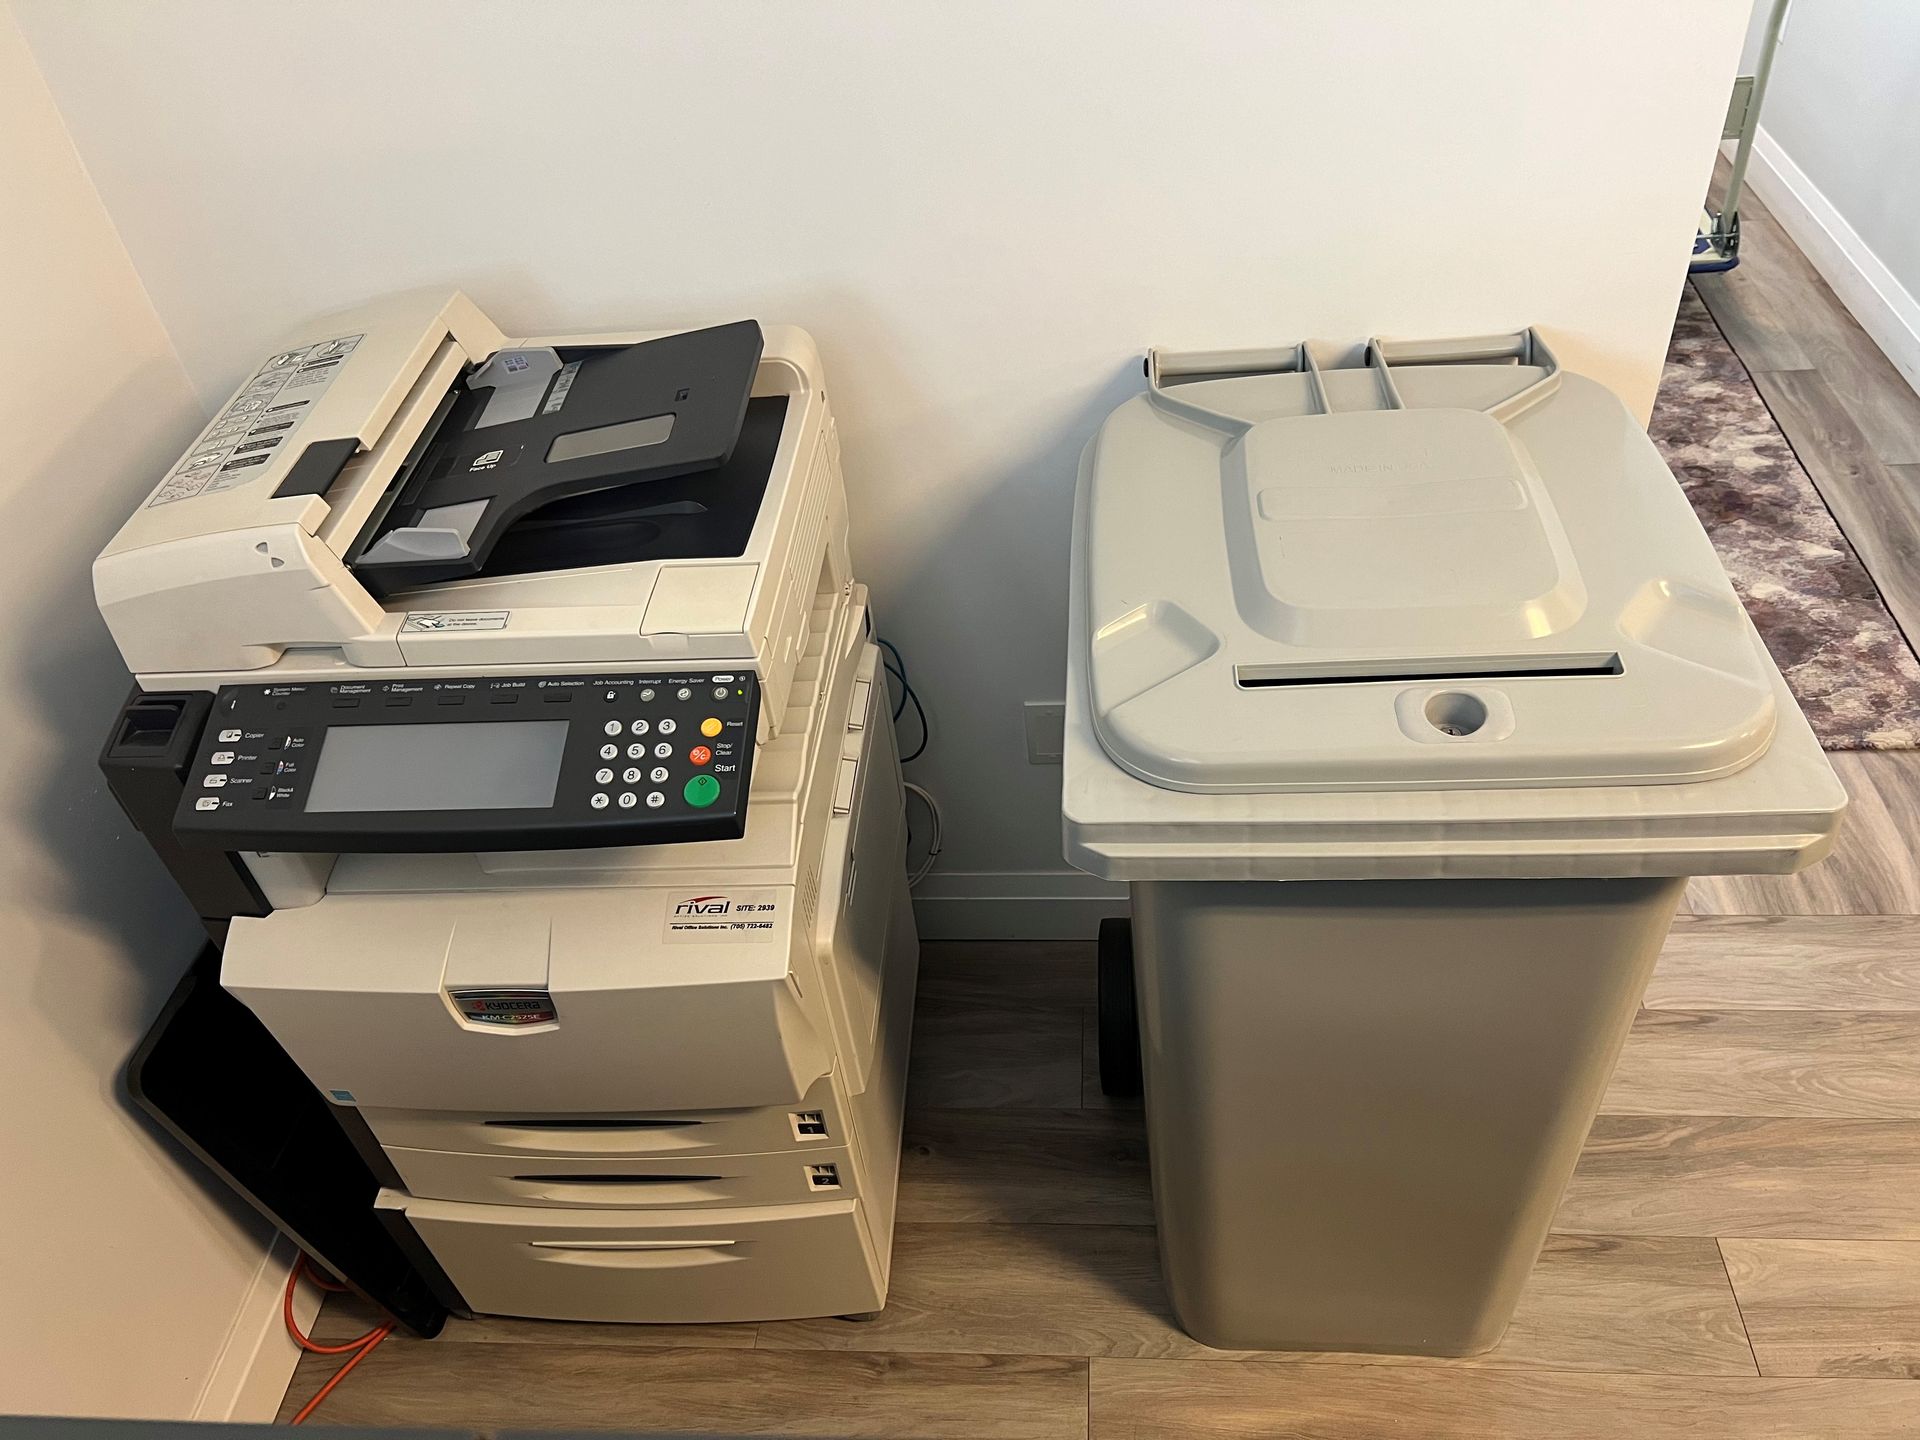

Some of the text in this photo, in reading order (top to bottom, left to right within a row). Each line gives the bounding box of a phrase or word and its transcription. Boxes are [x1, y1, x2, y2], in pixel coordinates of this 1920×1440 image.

[610, 721, 670, 732] 1 2 3
[603, 745, 666, 755] 4 5 6
[714, 764, 736, 772] Start
[600, 770, 663, 781] 7 8 9
[623, 795, 631, 805] 0
[675, 901, 731, 915] rival
[485, 1001, 541, 1010] KYOCERA
